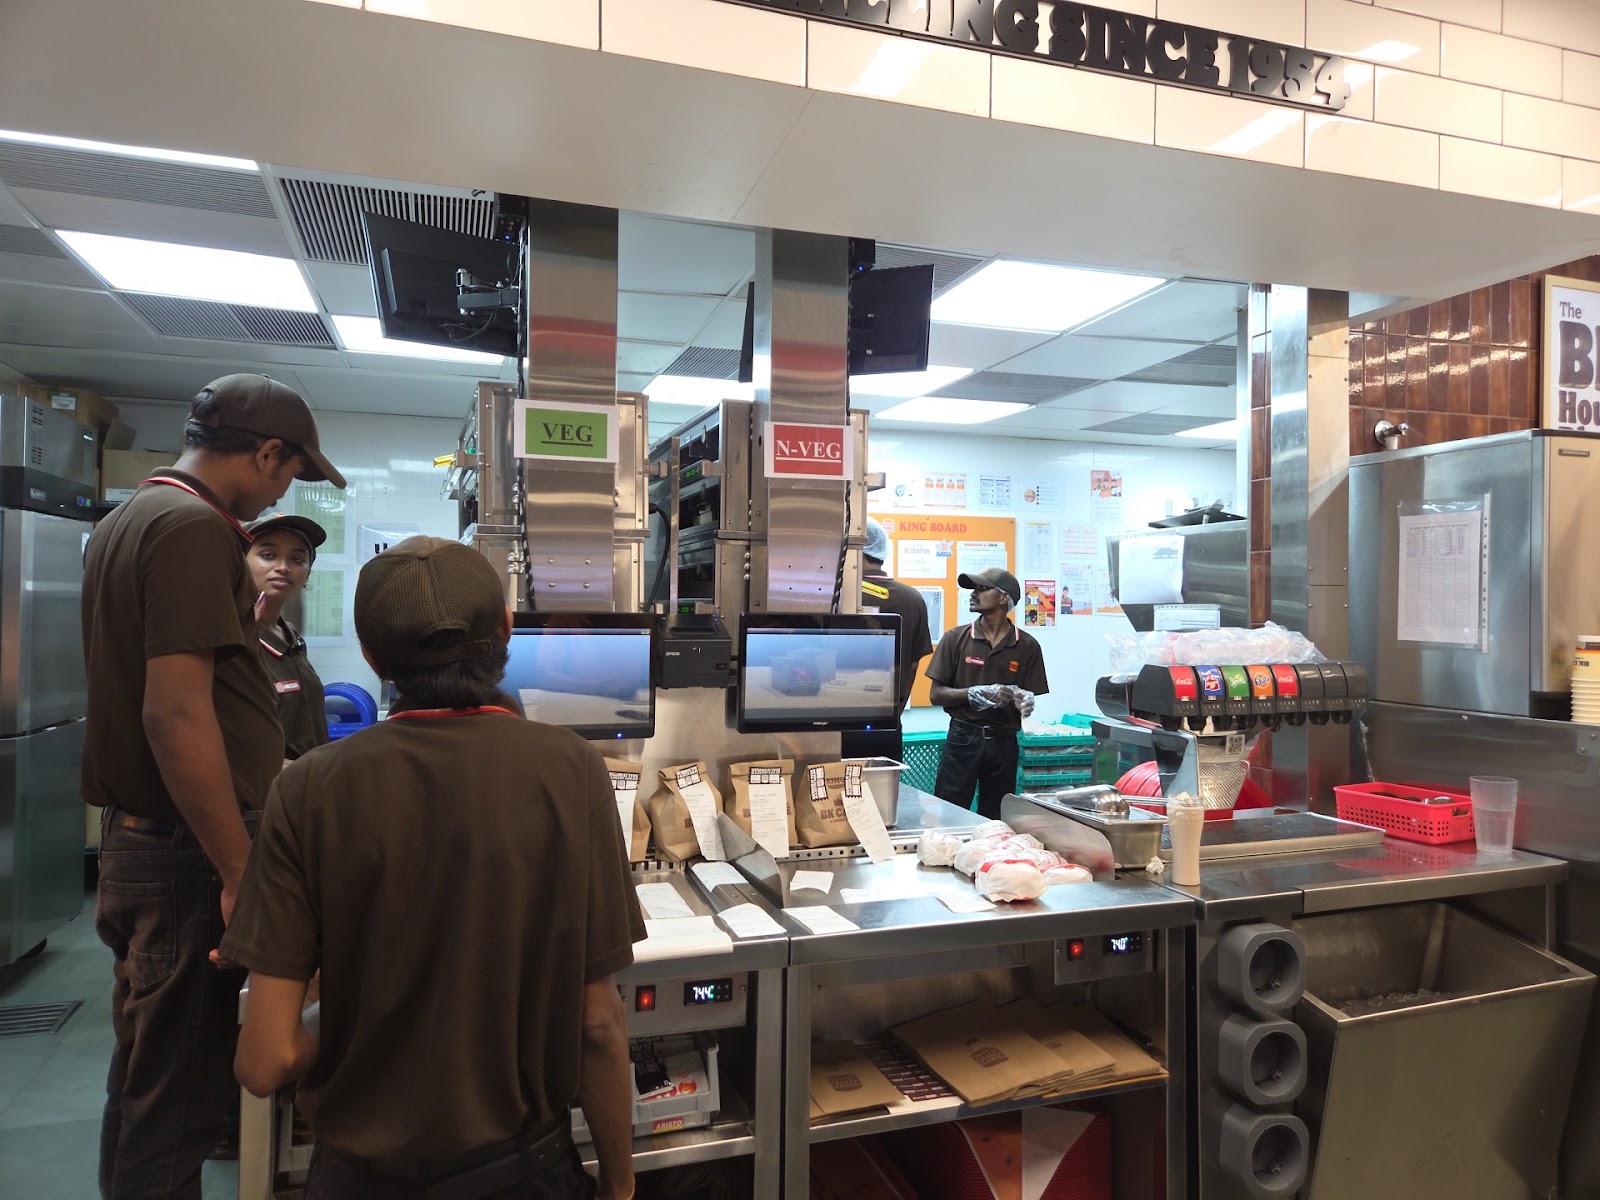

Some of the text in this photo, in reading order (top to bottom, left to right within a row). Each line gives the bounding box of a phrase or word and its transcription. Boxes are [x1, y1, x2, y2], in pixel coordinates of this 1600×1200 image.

[1048, 3, 1220, 87] SINCE
[1228, 36, 1351, 110] 1954
[1559, 301, 1583, 320] The
[1558, 320, 1600, 392] B
[542, 422, 593, 443] VEG
[775, 440, 841, 460] N-VEG
[899, 521, 927, 533] KING
[930, 522, 967, 533] BOARD
[820, 808, 835, 819] BK
[655, 1119, 682, 1130] ARISTO
